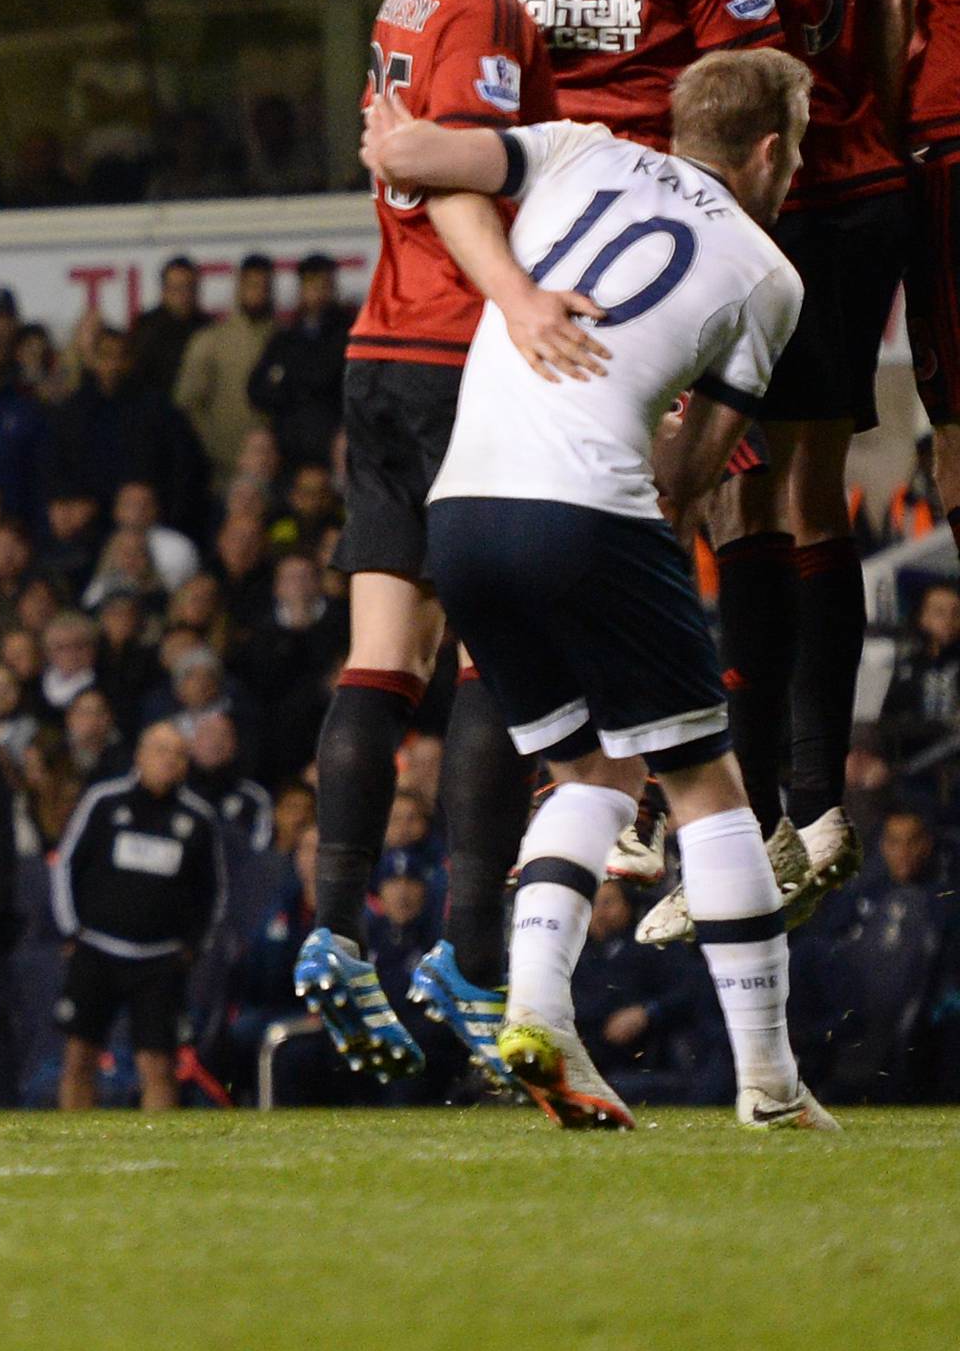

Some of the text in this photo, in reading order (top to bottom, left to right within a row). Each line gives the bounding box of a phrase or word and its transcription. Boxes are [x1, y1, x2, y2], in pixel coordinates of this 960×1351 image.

[552, 27, 642, 53] CBET
[632, 156, 730, 221] KANE
[528, 188, 702, 330] 10
[518, 916, 561, 931] URS
[715, 974, 779, 990] SPURS
